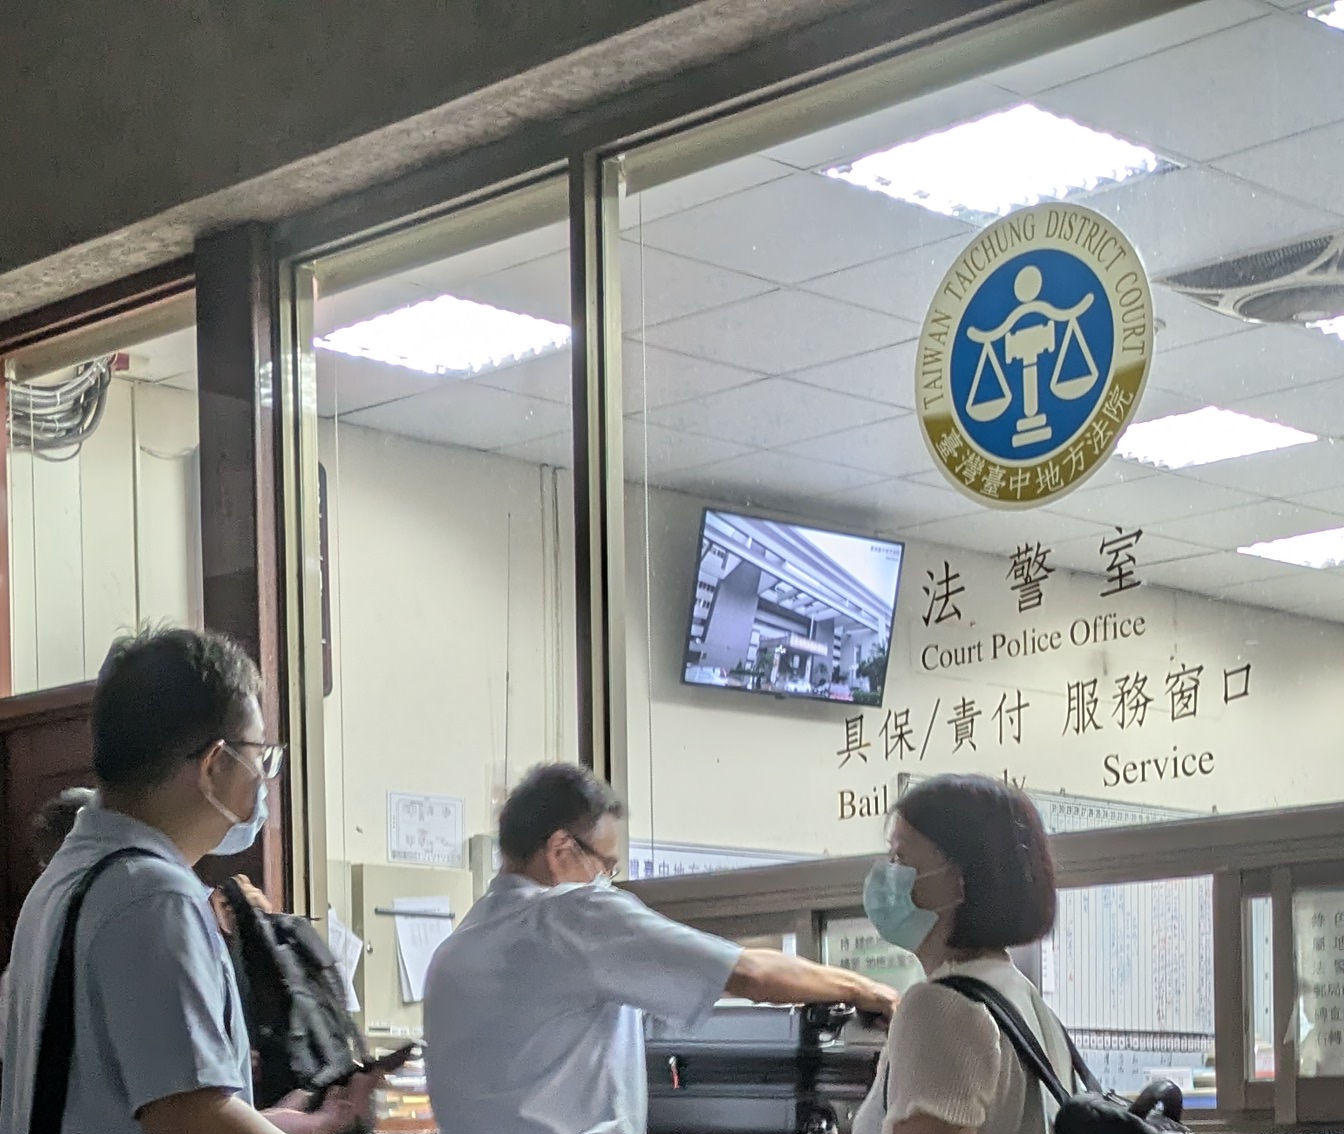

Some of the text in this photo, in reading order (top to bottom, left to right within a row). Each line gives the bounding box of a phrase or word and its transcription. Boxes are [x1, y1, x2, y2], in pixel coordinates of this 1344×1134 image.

[923, 209, 1146, 410] TAIWAN TAICHUNG DISTRICT COURT
[922, 526, 1145, 628] 法警室
[921, 613, 1147, 672] Court Police Office
[1061, 662, 1253, 738] 服務窗口
[838, 745, 1216, 821] Bail Service
